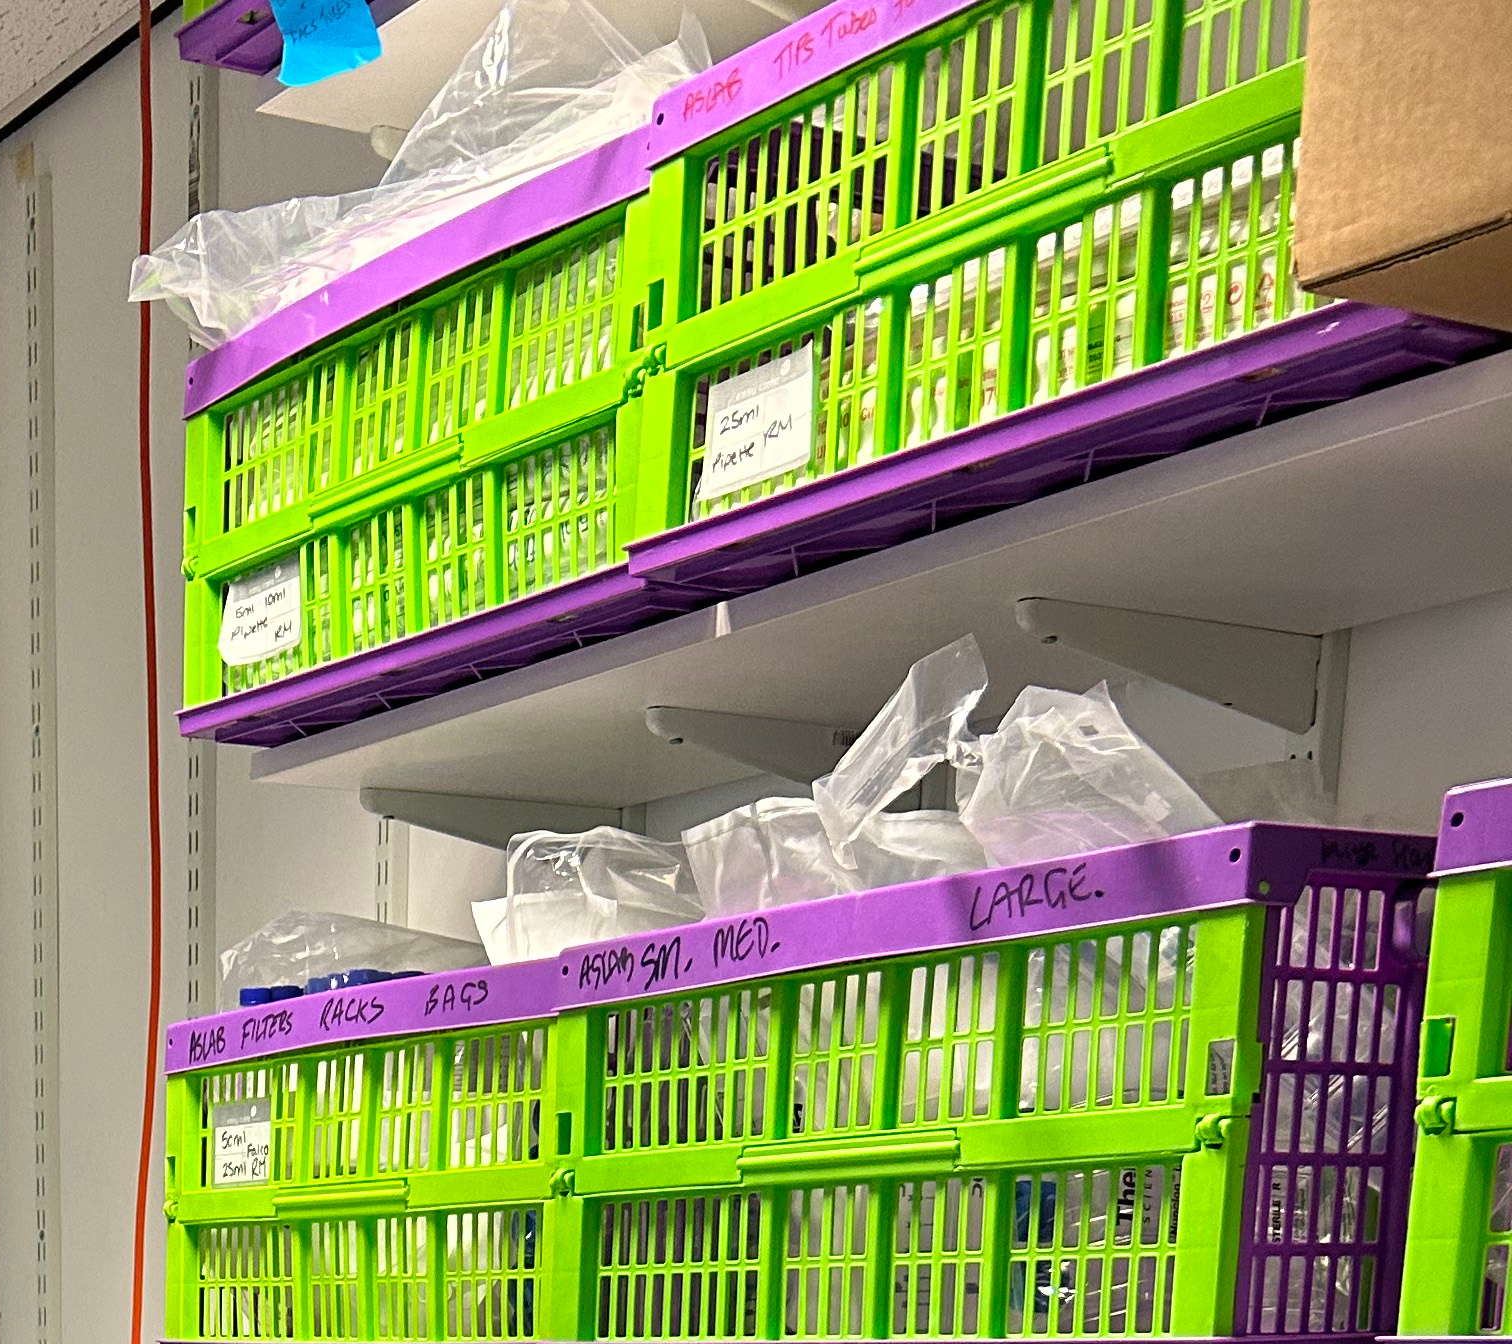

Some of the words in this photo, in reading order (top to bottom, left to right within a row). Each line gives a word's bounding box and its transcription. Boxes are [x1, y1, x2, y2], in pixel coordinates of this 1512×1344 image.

[720, 404, 759, 436] 25ml
[189, 1025, 227, 1065] ASLAB
[240, 1009, 293, 1050] FILTERS
[320, 996, 385, 1031] RACKS
[424, 979, 489, 1017] BAGS
[222, 1161, 247, 1178] 25ml
[1272, 1200, 1281, 1243] STERILE
